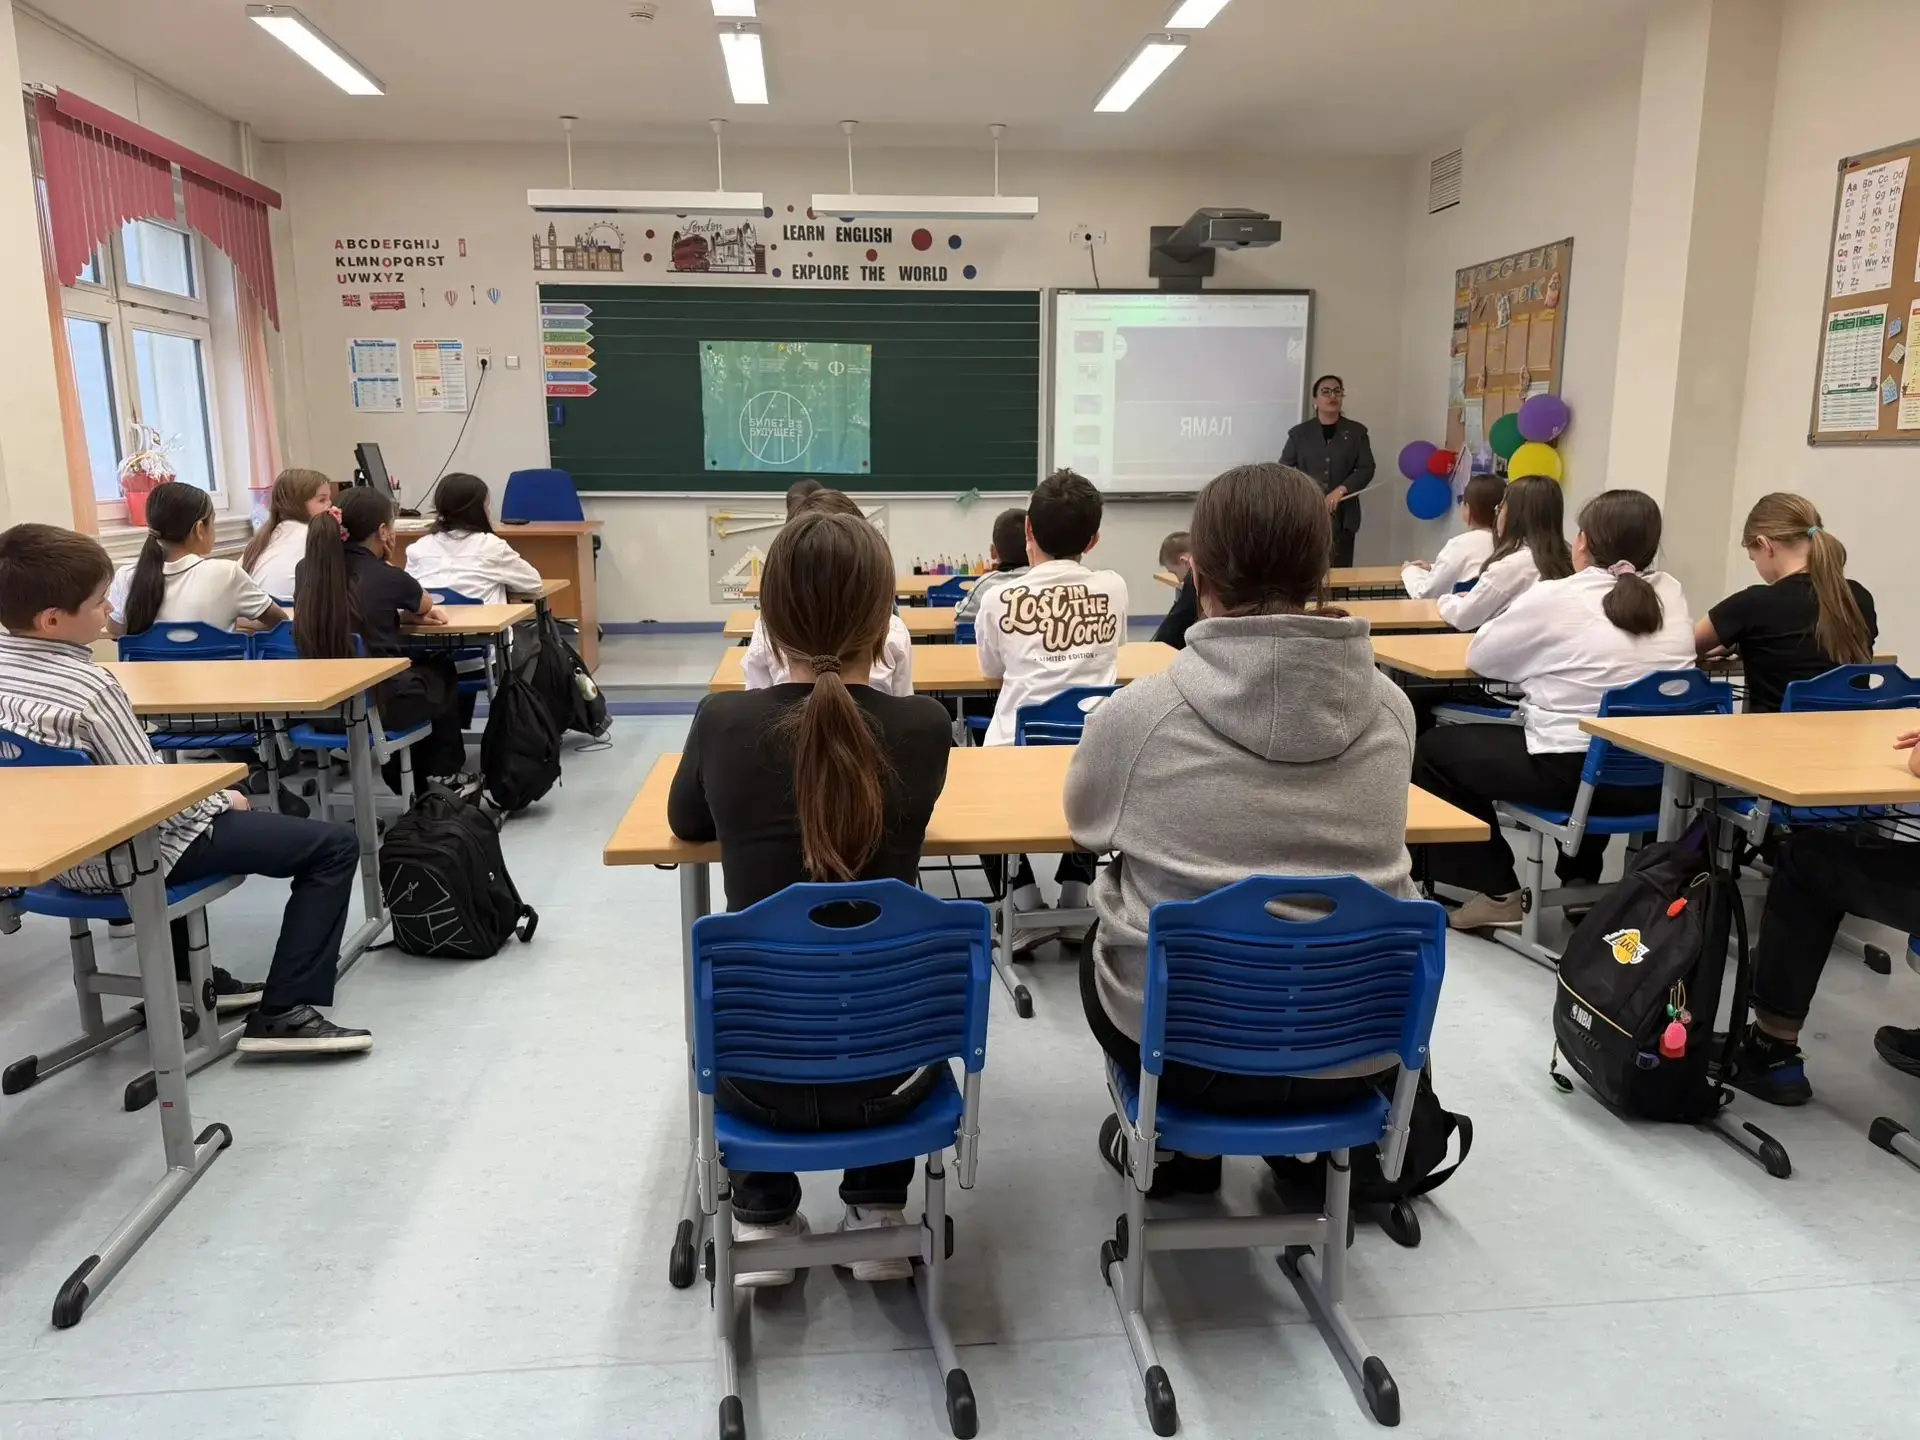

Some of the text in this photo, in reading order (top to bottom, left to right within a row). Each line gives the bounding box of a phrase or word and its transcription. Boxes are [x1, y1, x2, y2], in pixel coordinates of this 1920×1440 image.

[1846, 169, 1904, 192] Aa Bb Cc Dd
[1875, 190, 1886, 200] Gg
[1889, 186, 1900, 196] Hh
[1872, 208, 1882, 216] Kk
[682, 218, 723, 236] London
[783, 225, 892, 243] LEARN ENGLISH
[1839, 232, 1851, 240] Mm
[1855, 229, 1865, 238] Nn
[1885, 221, 1895, 231] Pp
[1837, 249, 1848, 257] Qq
[1853, 246, 1862, 254] Rr
[792, 264, 948, 281] EXPLORE THE WORLD
[1836, 264, 1846, 273] Uu
[1865, 259, 1878, 267] Ww
[1881, 255, 1890, 264] Xx
[1836, 278, 1859, 290] Yy Zz
[544, 320, 550, 328] 2
[548, 373, 554, 381] 6
[750, 418, 785, 427] БИЛЕТ
[1180, 416, 1232, 438] ЯМАЛ
[1000, 585, 1087, 634] Lost IN
[1069, 596, 1108, 616] THE
[1039, 615, 1117, 652] World
[1039, 652, 1094, 663] LIMITED EDITION
[1576, 1008, 1593, 1030] NBA
